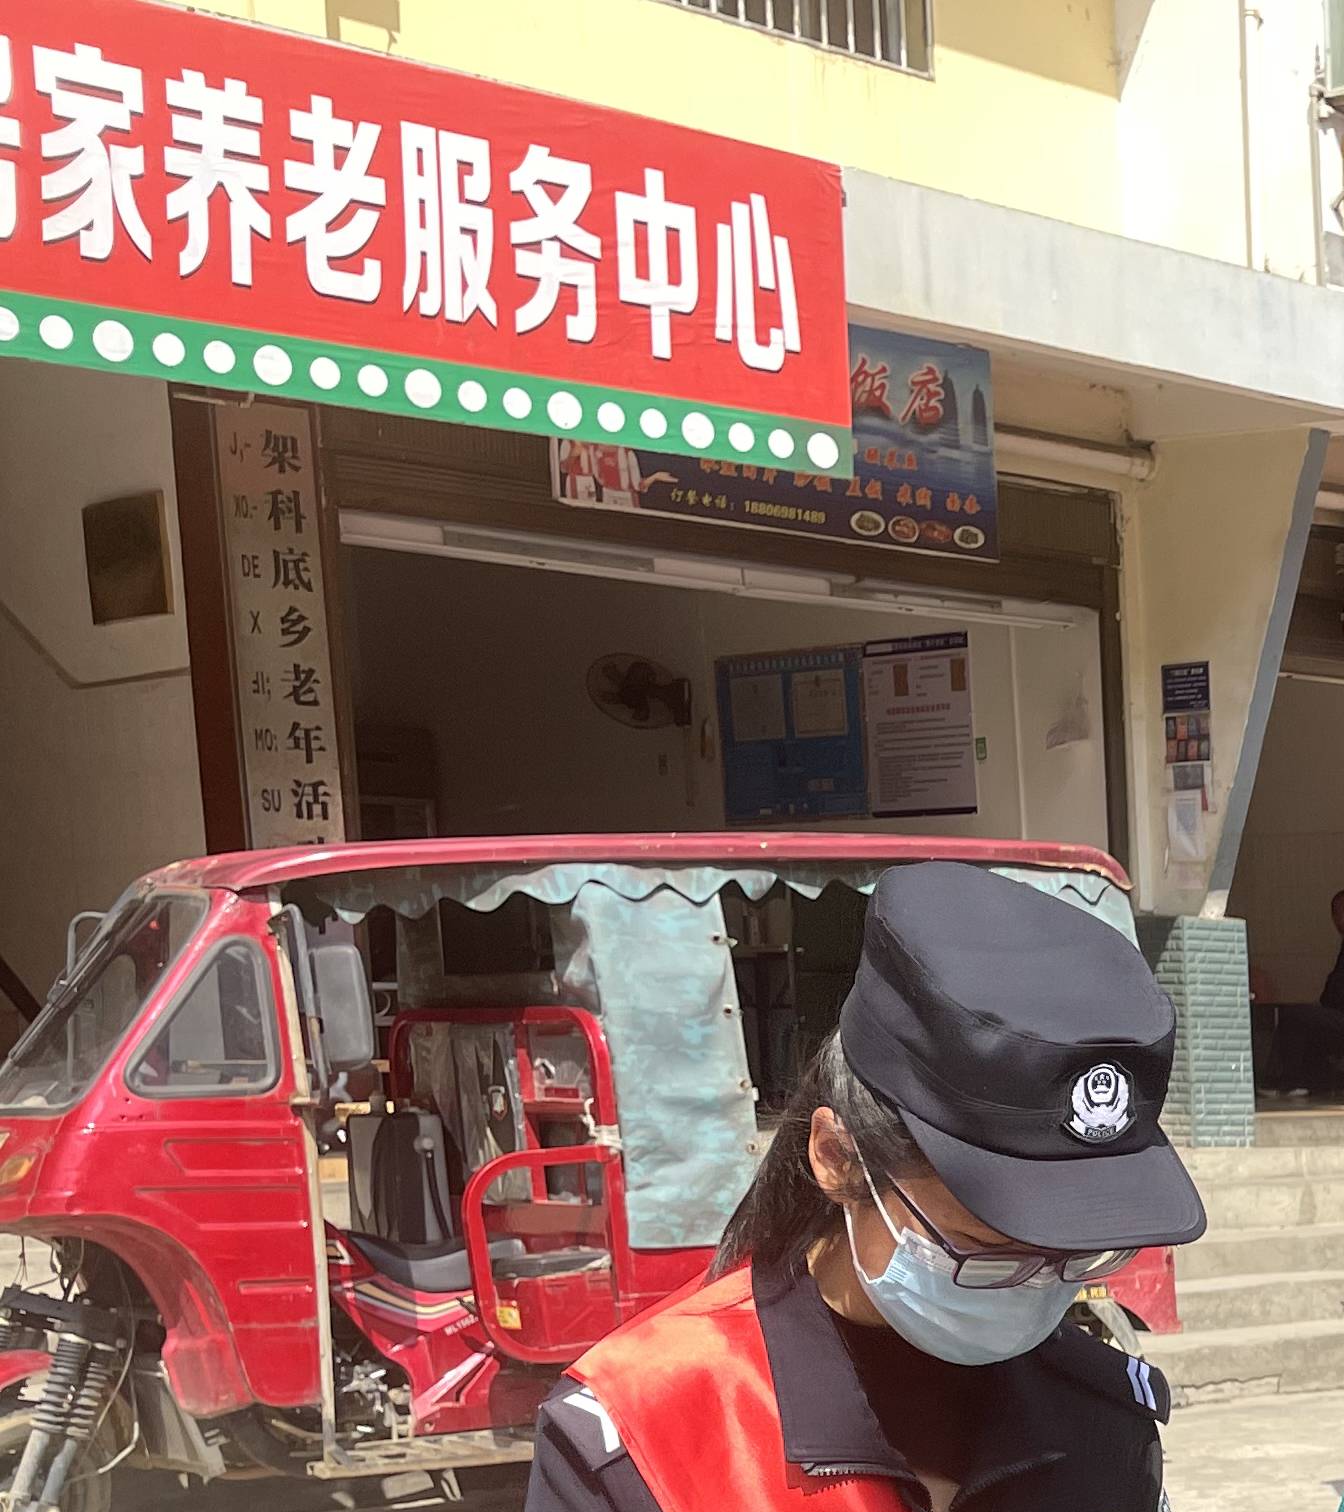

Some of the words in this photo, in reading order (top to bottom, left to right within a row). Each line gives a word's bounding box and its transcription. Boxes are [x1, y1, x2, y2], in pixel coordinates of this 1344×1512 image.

[0, 34, 802, 372] 家养老服务中心
[260, 428, 332, 846] 架科底乡老年活
